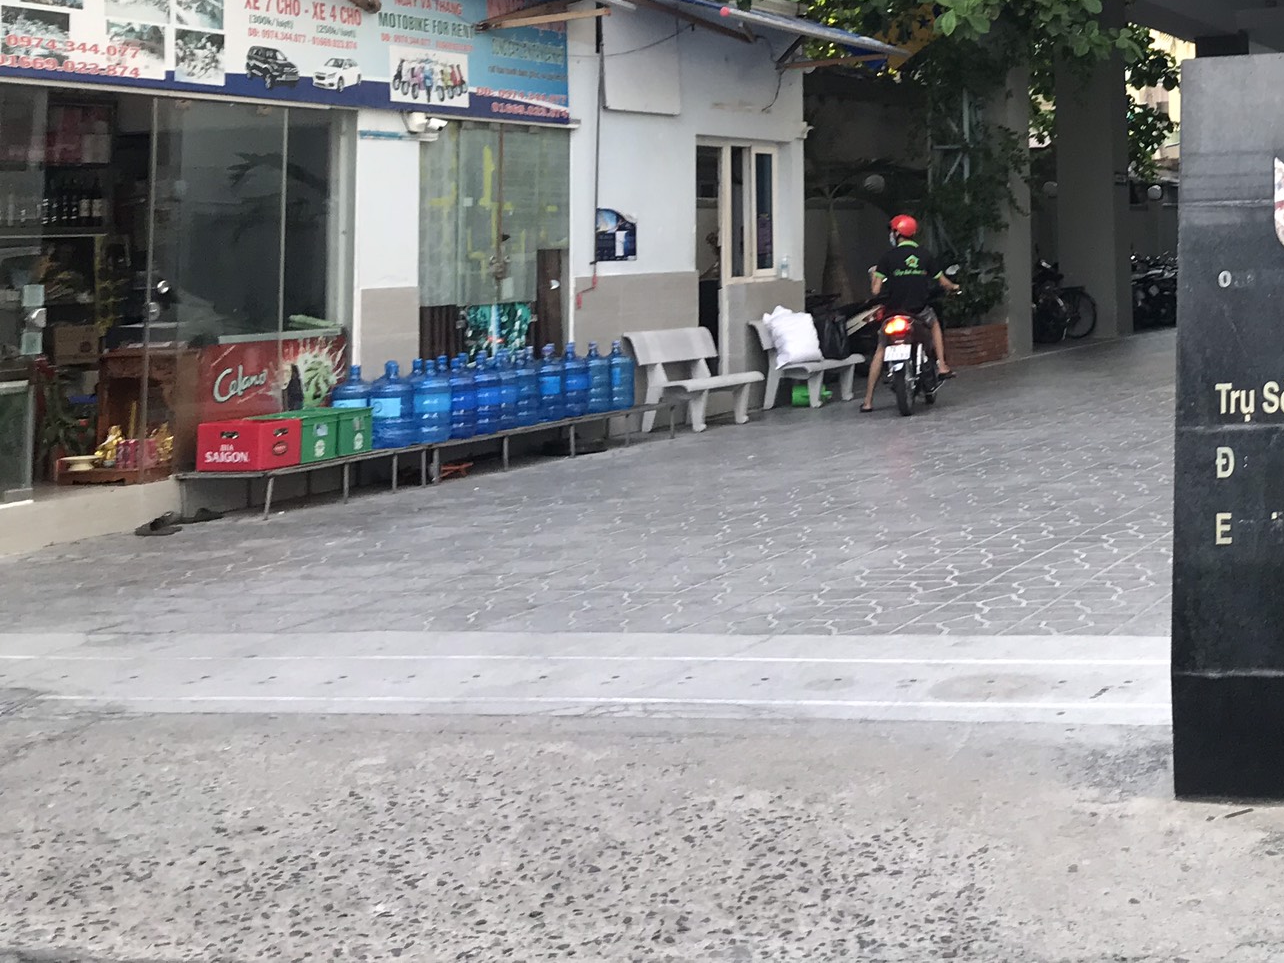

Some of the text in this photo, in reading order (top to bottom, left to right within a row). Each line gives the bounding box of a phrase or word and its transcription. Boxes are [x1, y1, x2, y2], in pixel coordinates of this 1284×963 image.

[312, 1, 326, 21] XE
[329, 4, 338, 23] 4
[378, 11, 430, 33] MOTOBIKE
[432, 19, 449, 36] FOR
[1215, 381, 1255, 423] Trụ
